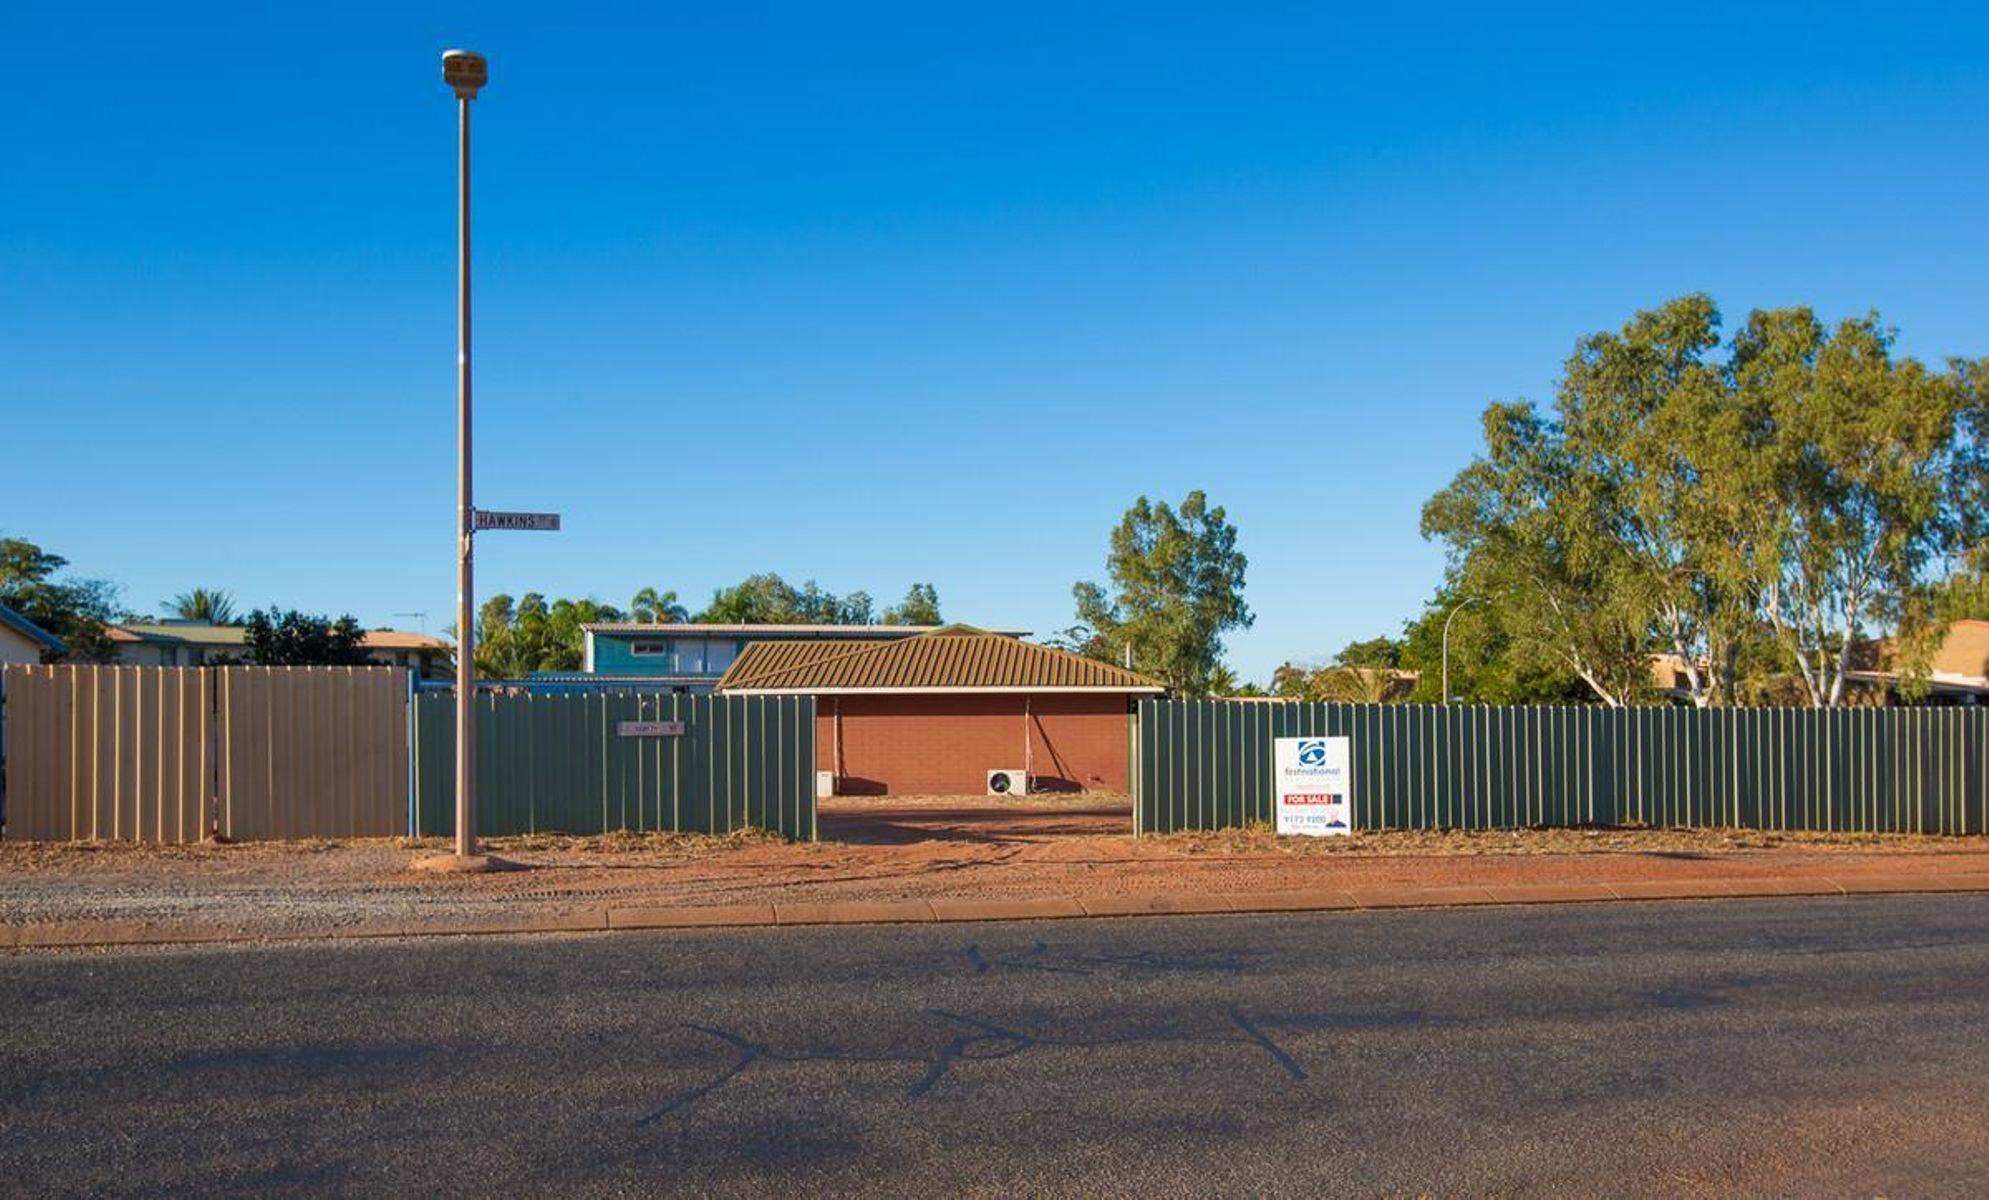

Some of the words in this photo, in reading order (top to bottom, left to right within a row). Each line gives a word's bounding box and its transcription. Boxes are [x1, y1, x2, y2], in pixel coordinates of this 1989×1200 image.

[479, 514, 535, 528] HAWKINS
[1288, 795, 1304, 804] FOR
[1307, 795, 1329, 804] SALE
